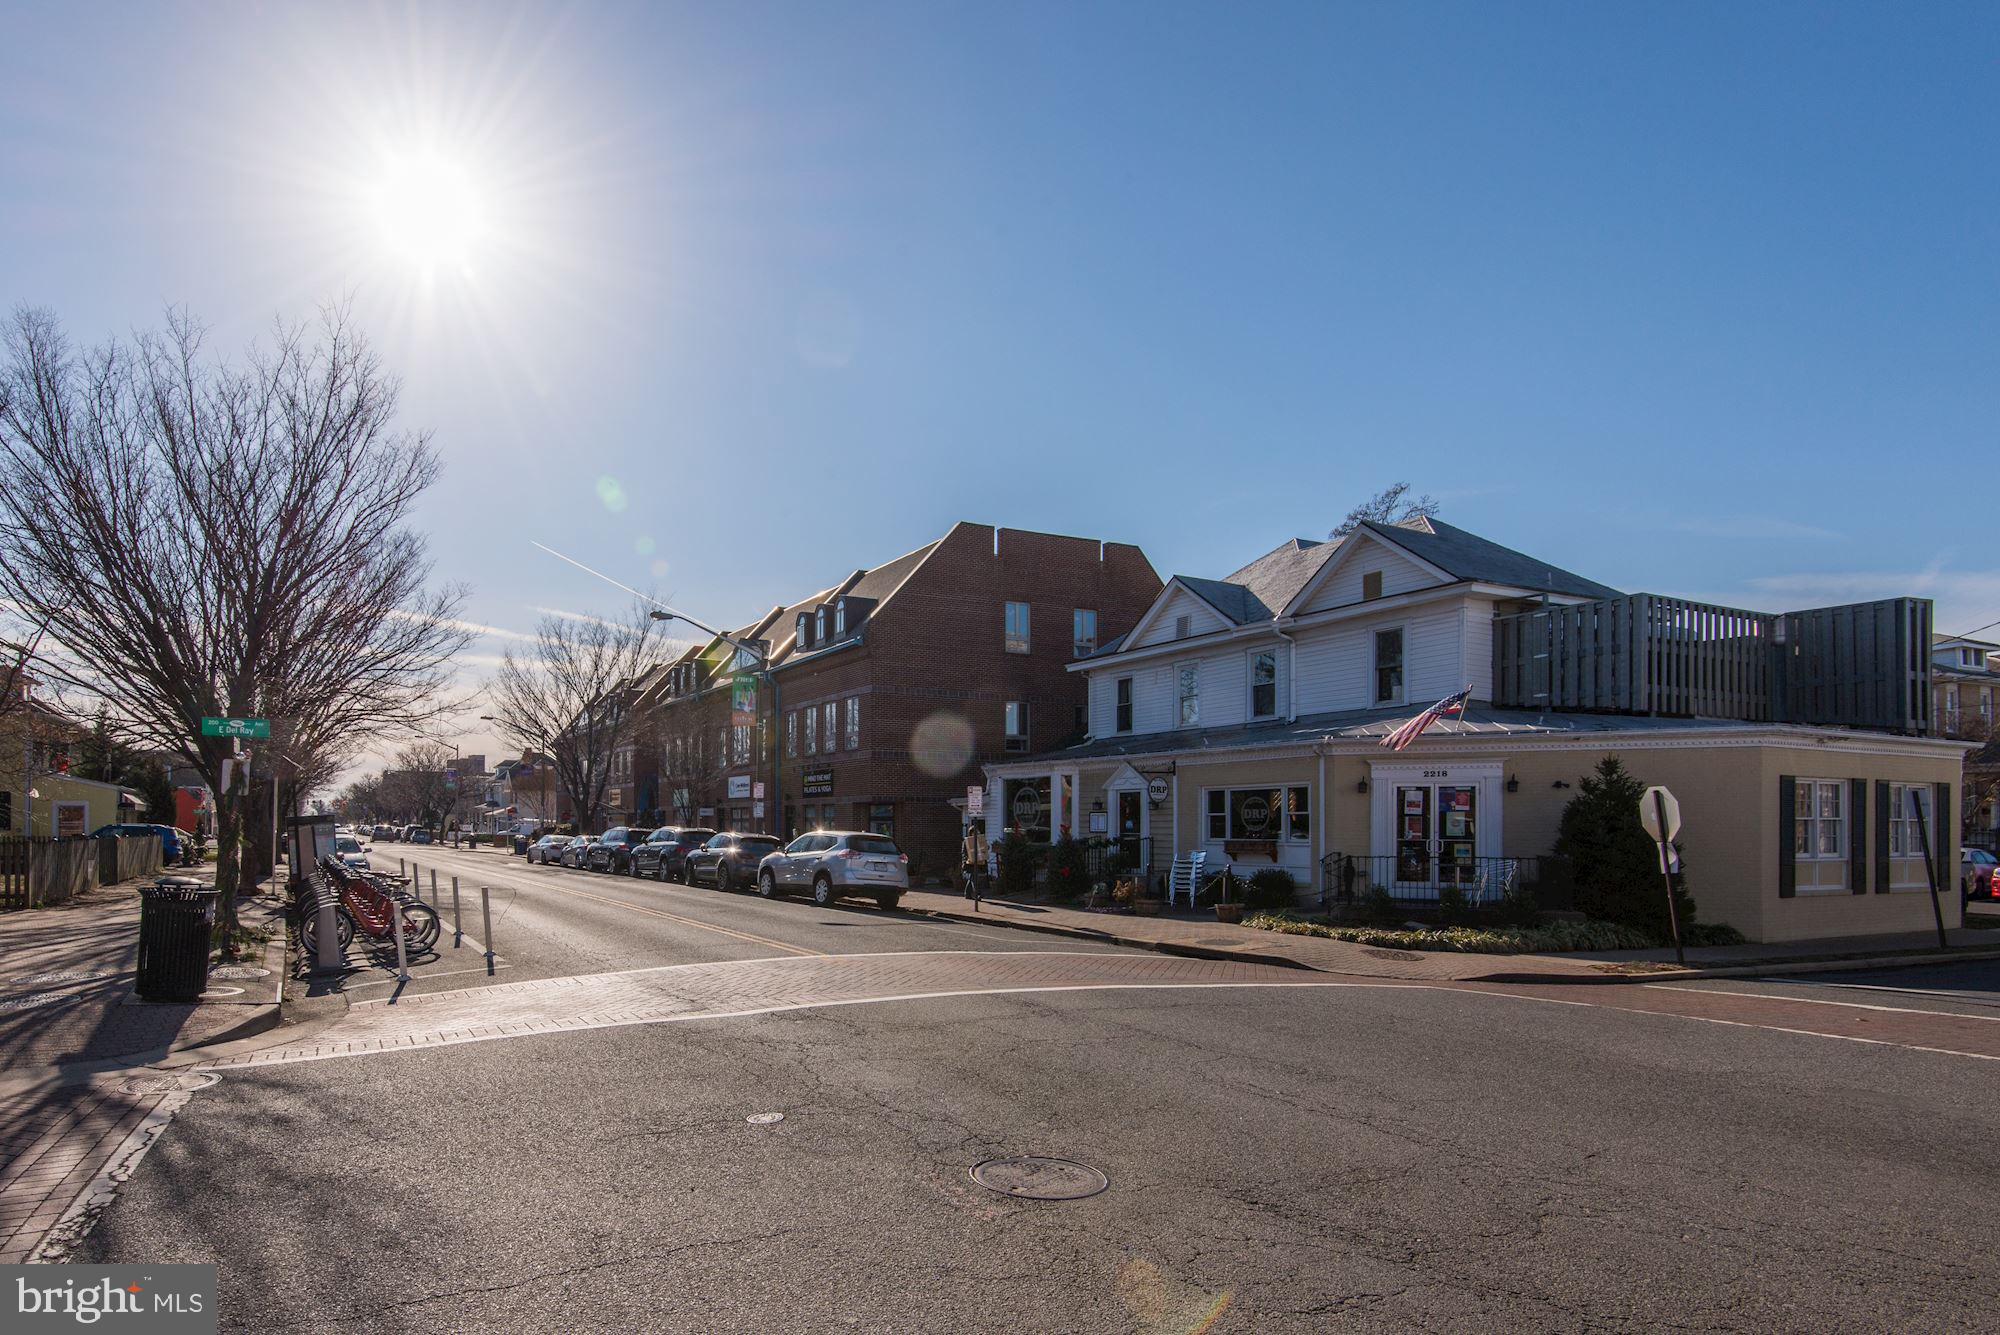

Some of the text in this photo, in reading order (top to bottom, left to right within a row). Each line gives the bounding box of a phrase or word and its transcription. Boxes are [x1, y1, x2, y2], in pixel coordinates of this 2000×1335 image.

[226, 726, 238, 734] Del
[240, 727, 254, 735] Ray
[1150, 785, 1167, 793] DRP
[1015, 802, 1039, 814] DRP
[1243, 808, 1267, 819] DRP
